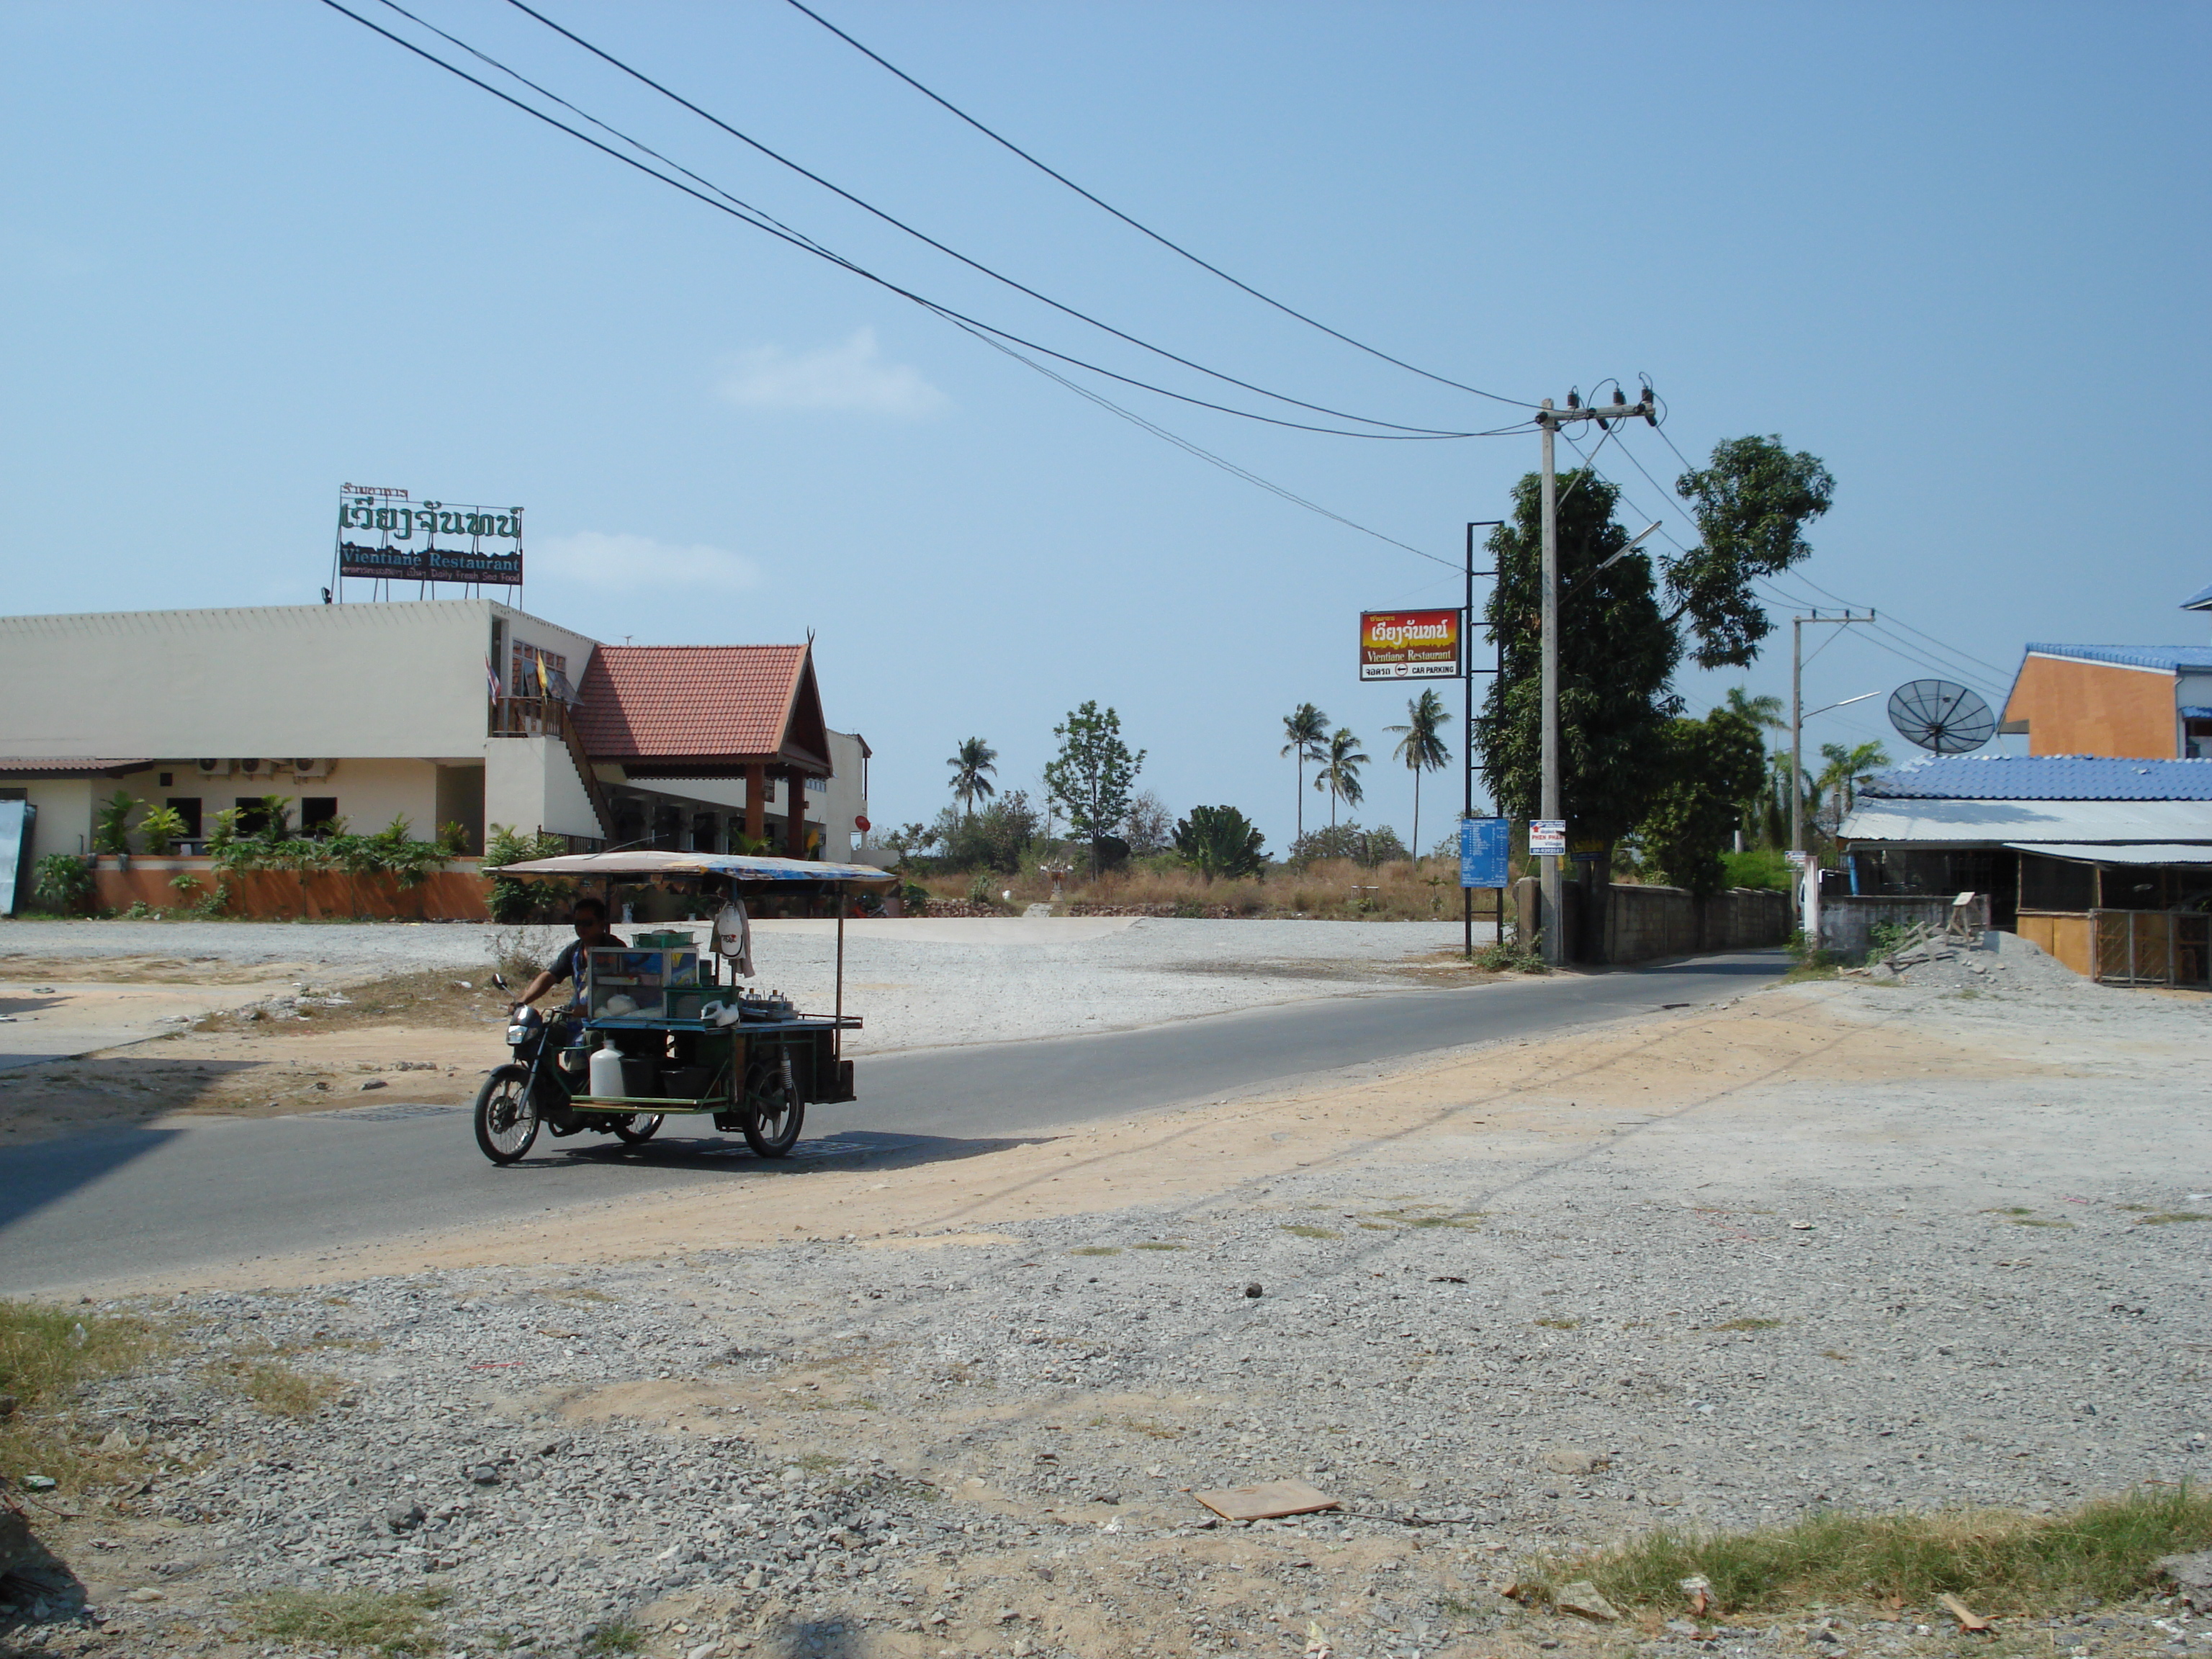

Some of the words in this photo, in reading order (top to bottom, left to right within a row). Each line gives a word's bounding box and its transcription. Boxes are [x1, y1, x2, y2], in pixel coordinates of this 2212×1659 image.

[343, 482, 408, 497] ร้านอาหาร
[341, 497, 524, 540] เวียงจันทน์
[342, 548, 422, 565] Vientiane
[428, 552, 520, 571] Restaurant
[431, 569, 452, 580] Daily
[456, 570, 479, 580] Fresh
[482, 572, 498, 581] Sea
[500, 572, 520, 582] Food
[1372, 619, 1448, 645] เวียงจันทน์
[1367, 650, 1405, 662] Vientiane
[1407, 649, 1451, 661] Restaurant
